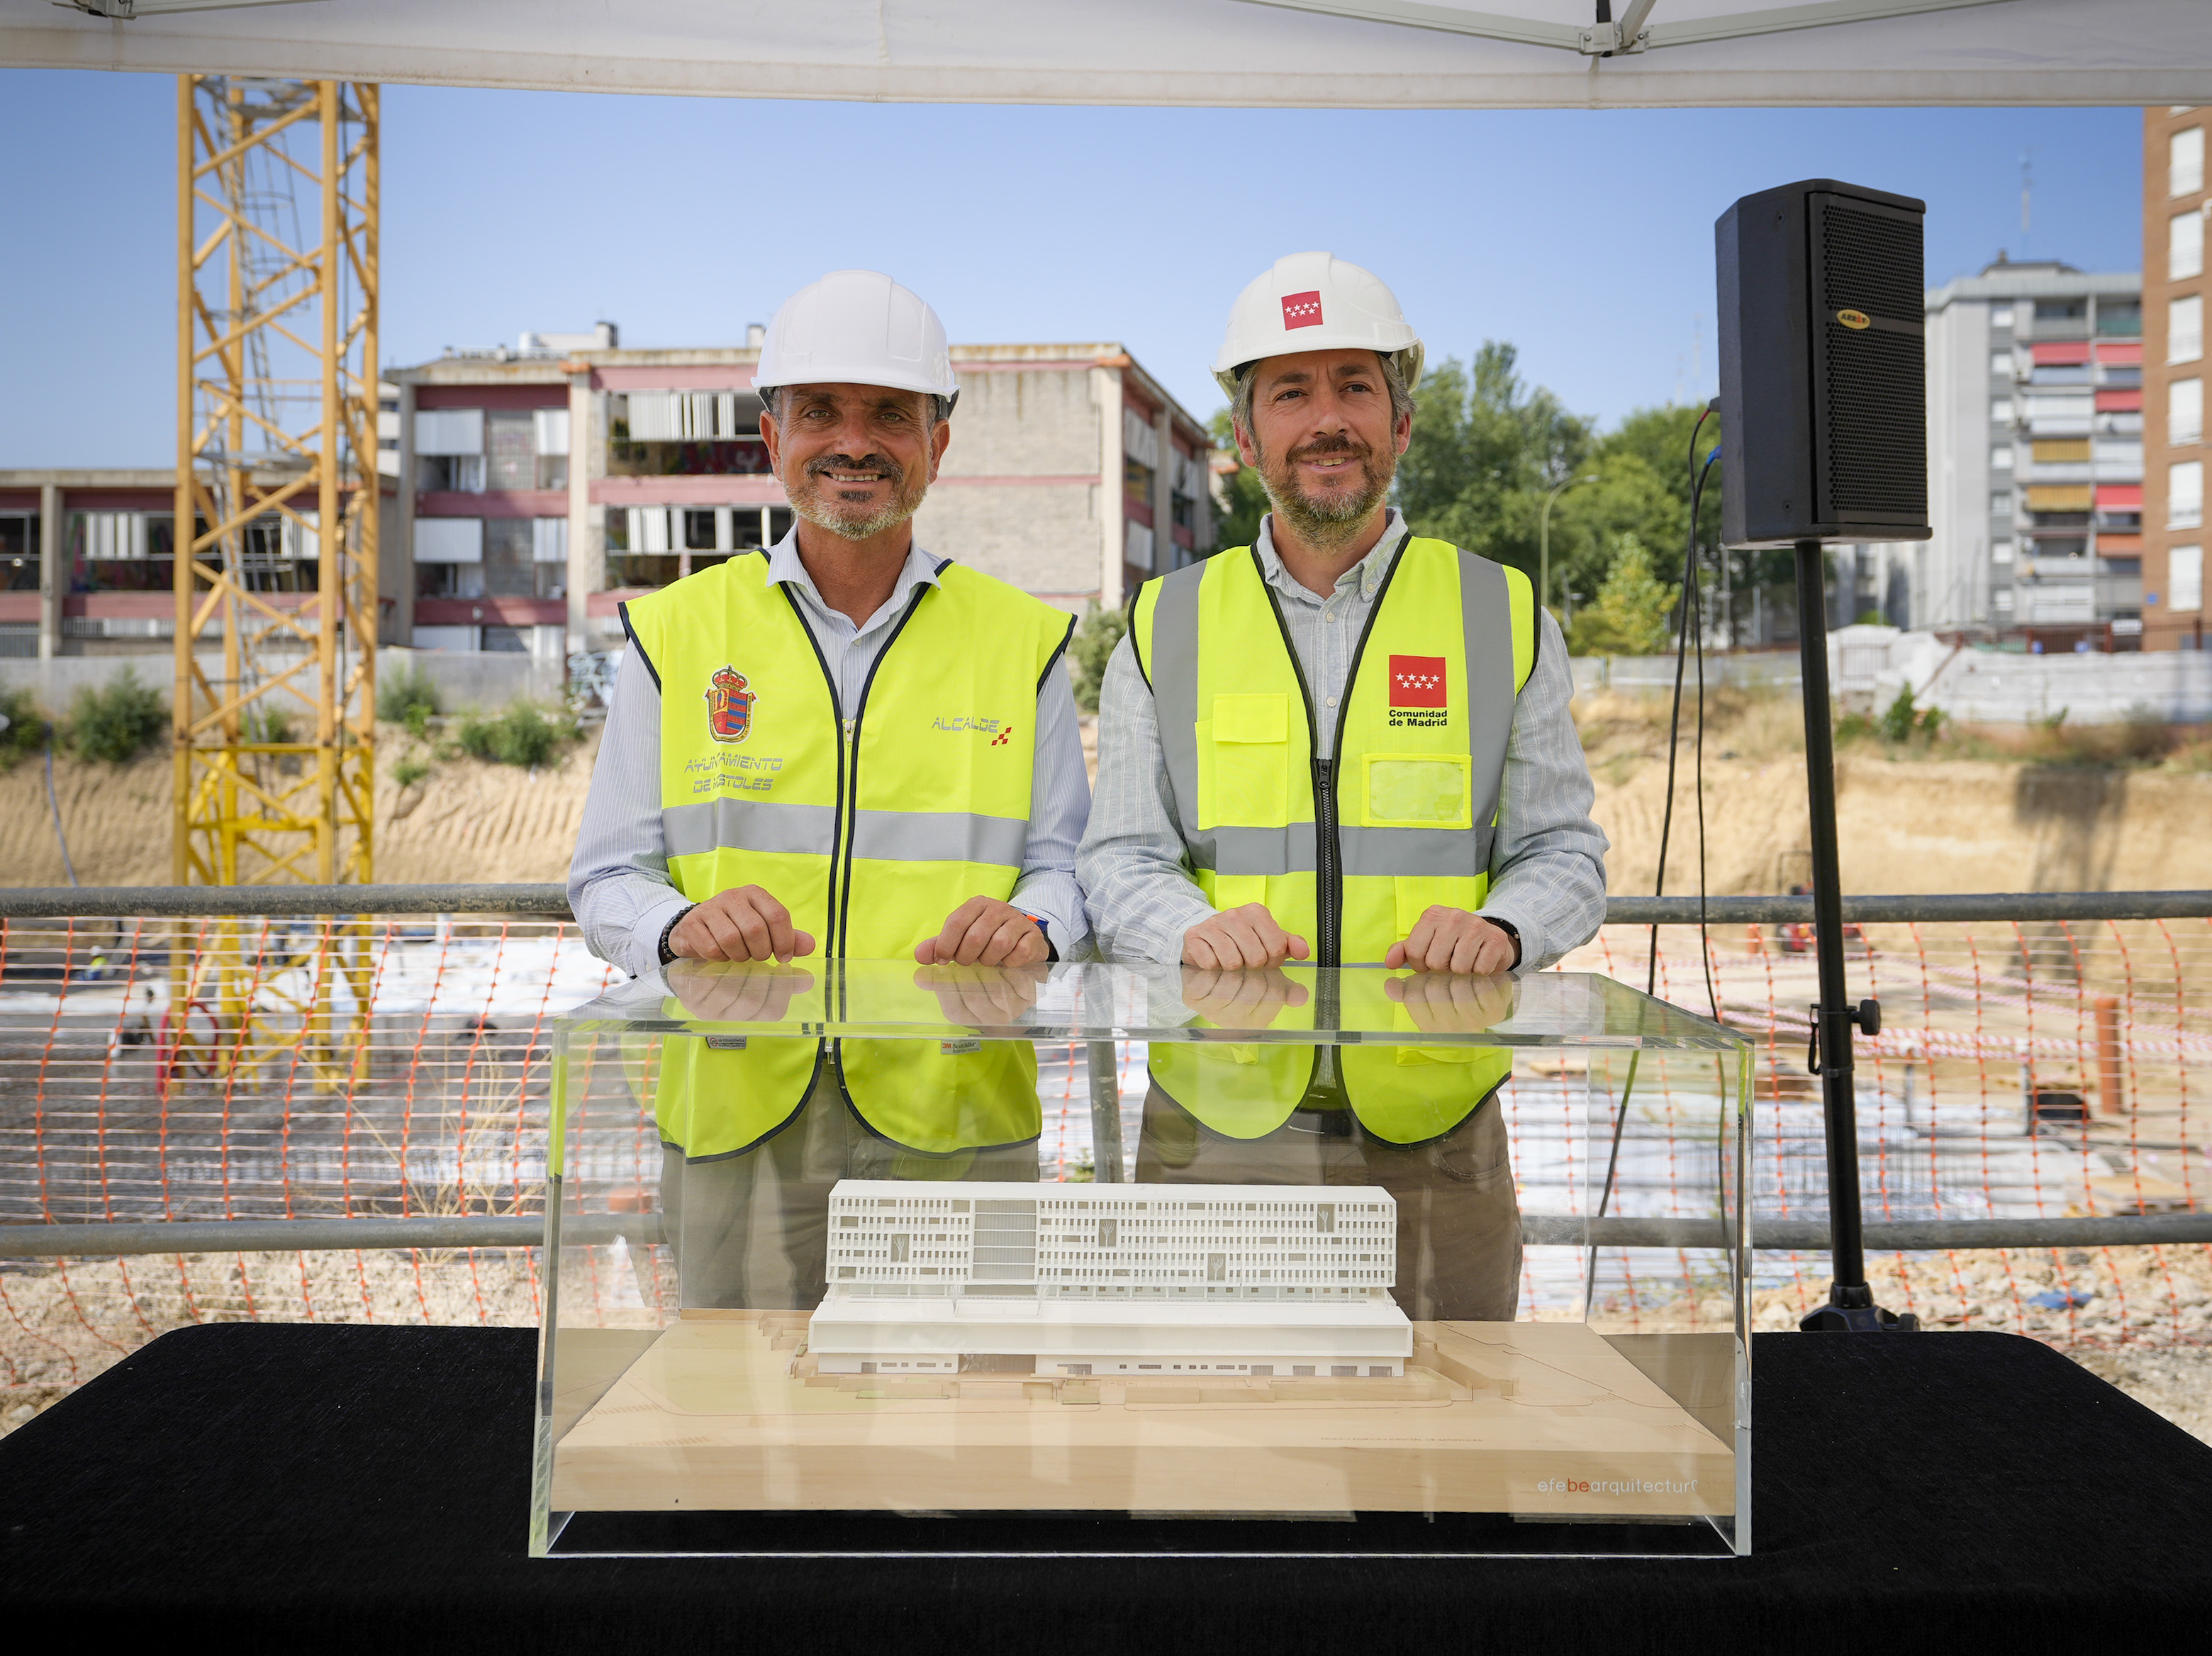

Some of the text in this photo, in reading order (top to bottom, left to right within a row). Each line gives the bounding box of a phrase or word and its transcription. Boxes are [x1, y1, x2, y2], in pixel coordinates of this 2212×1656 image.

[1841, 313, 1867, 323] ARRAY
[932, 716, 1000, 733] ALCALDE
[1389, 718, 1448, 727] de Madrid
[693, 773, 774, 793] DE MSTOLES
